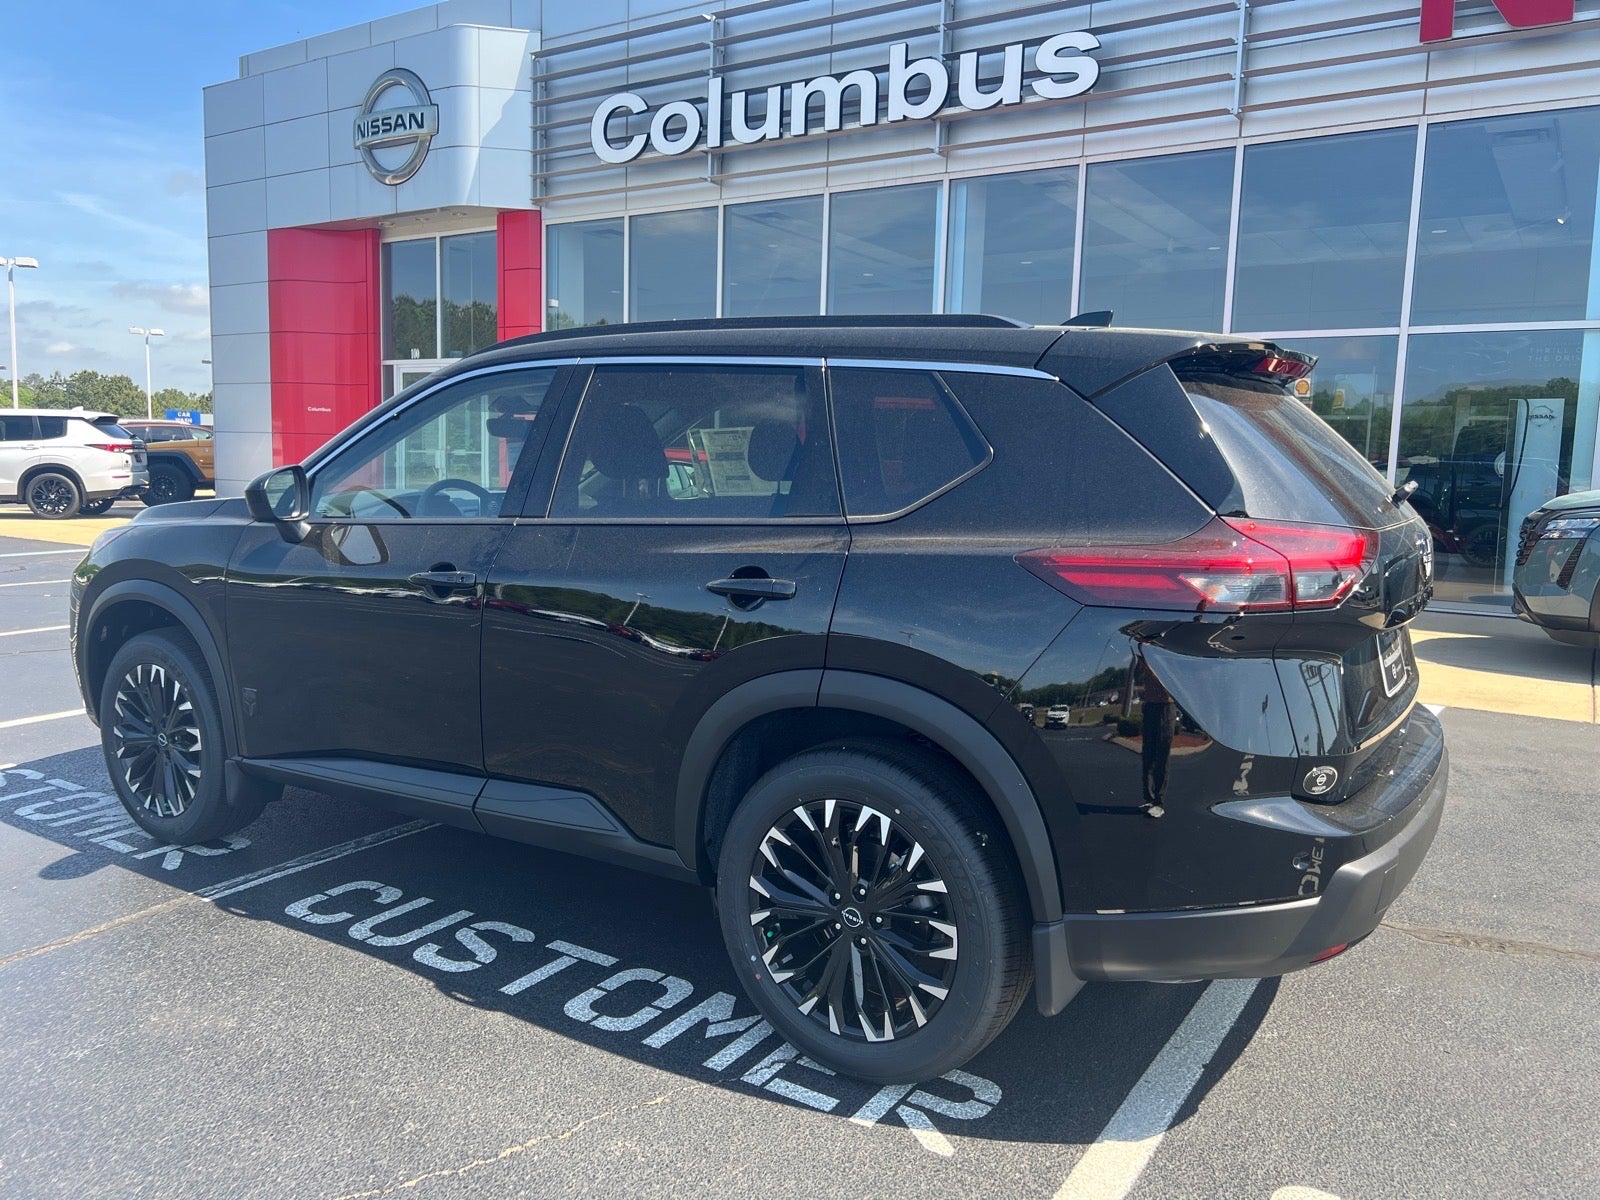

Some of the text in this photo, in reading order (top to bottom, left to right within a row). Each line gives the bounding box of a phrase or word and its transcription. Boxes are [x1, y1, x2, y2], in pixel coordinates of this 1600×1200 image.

[356, 111, 425, 141] NISSAN
[590, 30, 1101, 165] Columbus
[283, 880, 1003, 1157] CUSTOMER
